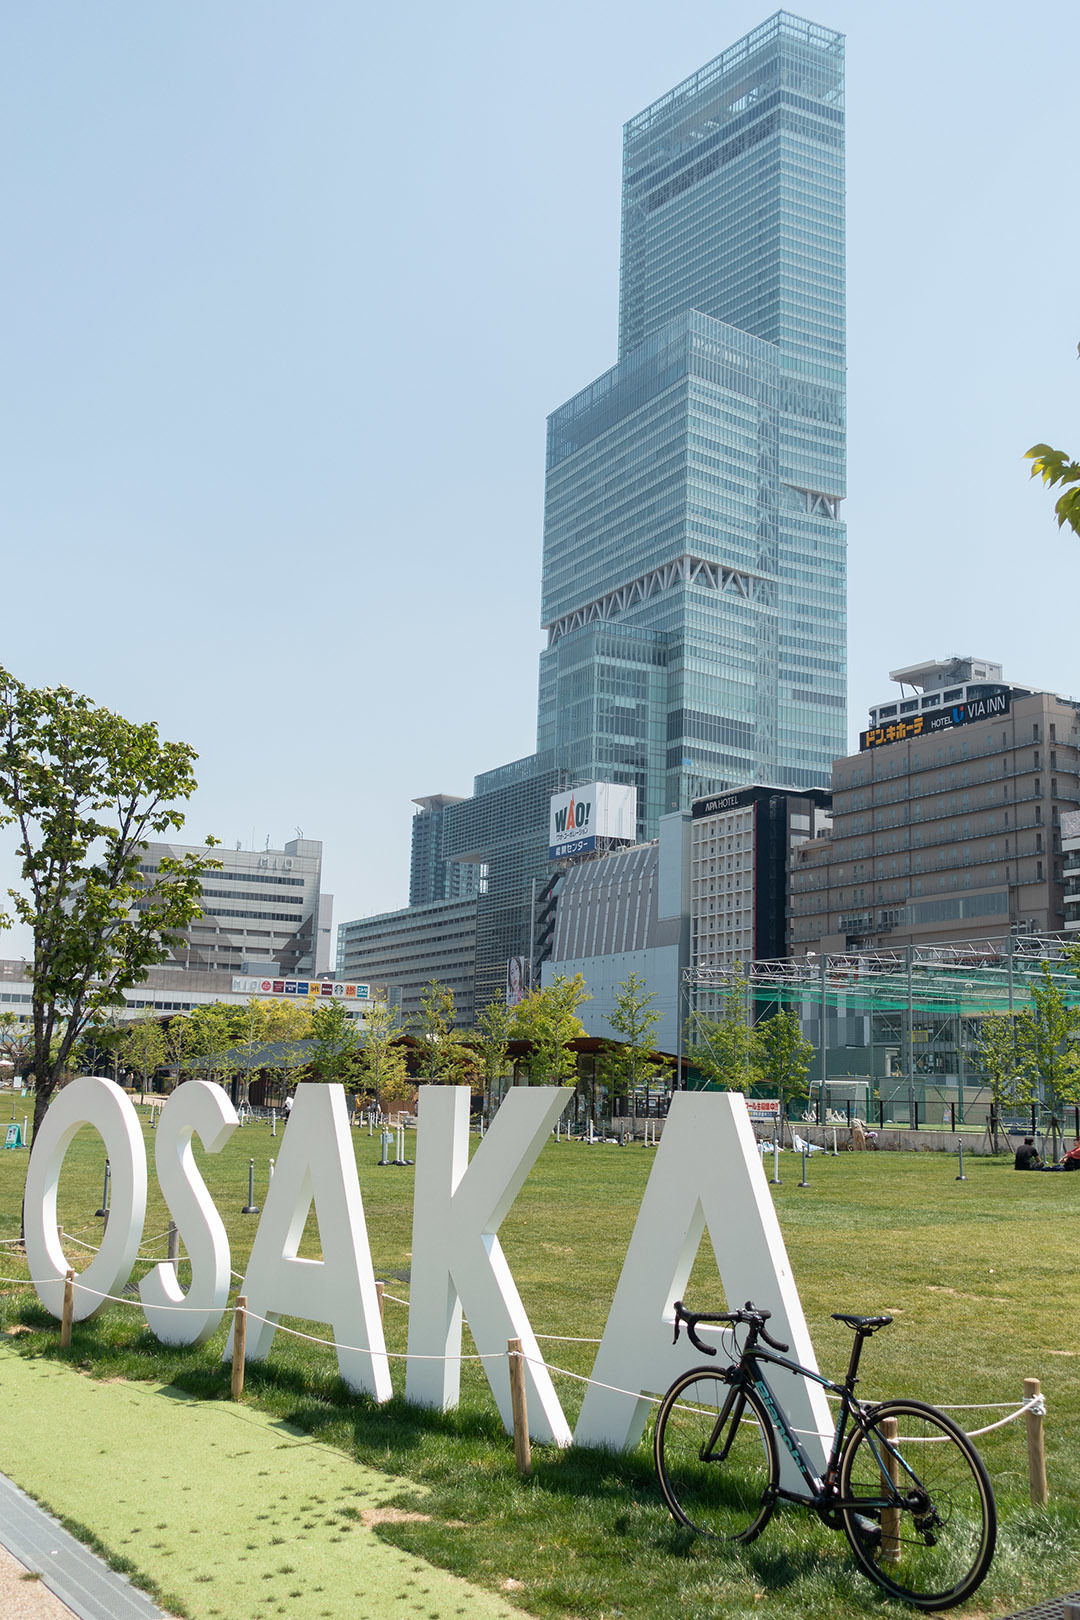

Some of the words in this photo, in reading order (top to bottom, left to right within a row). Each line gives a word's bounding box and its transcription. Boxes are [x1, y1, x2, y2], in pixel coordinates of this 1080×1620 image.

[931, 717, 953, 729] HOTEL
[967, 703, 985, 718] VIA
[986, 695, 1006, 714] INN
[555, 792, 591, 833] WAO!
[705, 802, 717, 812] APA
[718, 796, 739, 808] HOTEL
[260, 855, 294, 869] MIO
[24, 1076, 836, 1496] OSAKA
[754, 1380, 807, 1473] Bianchi
